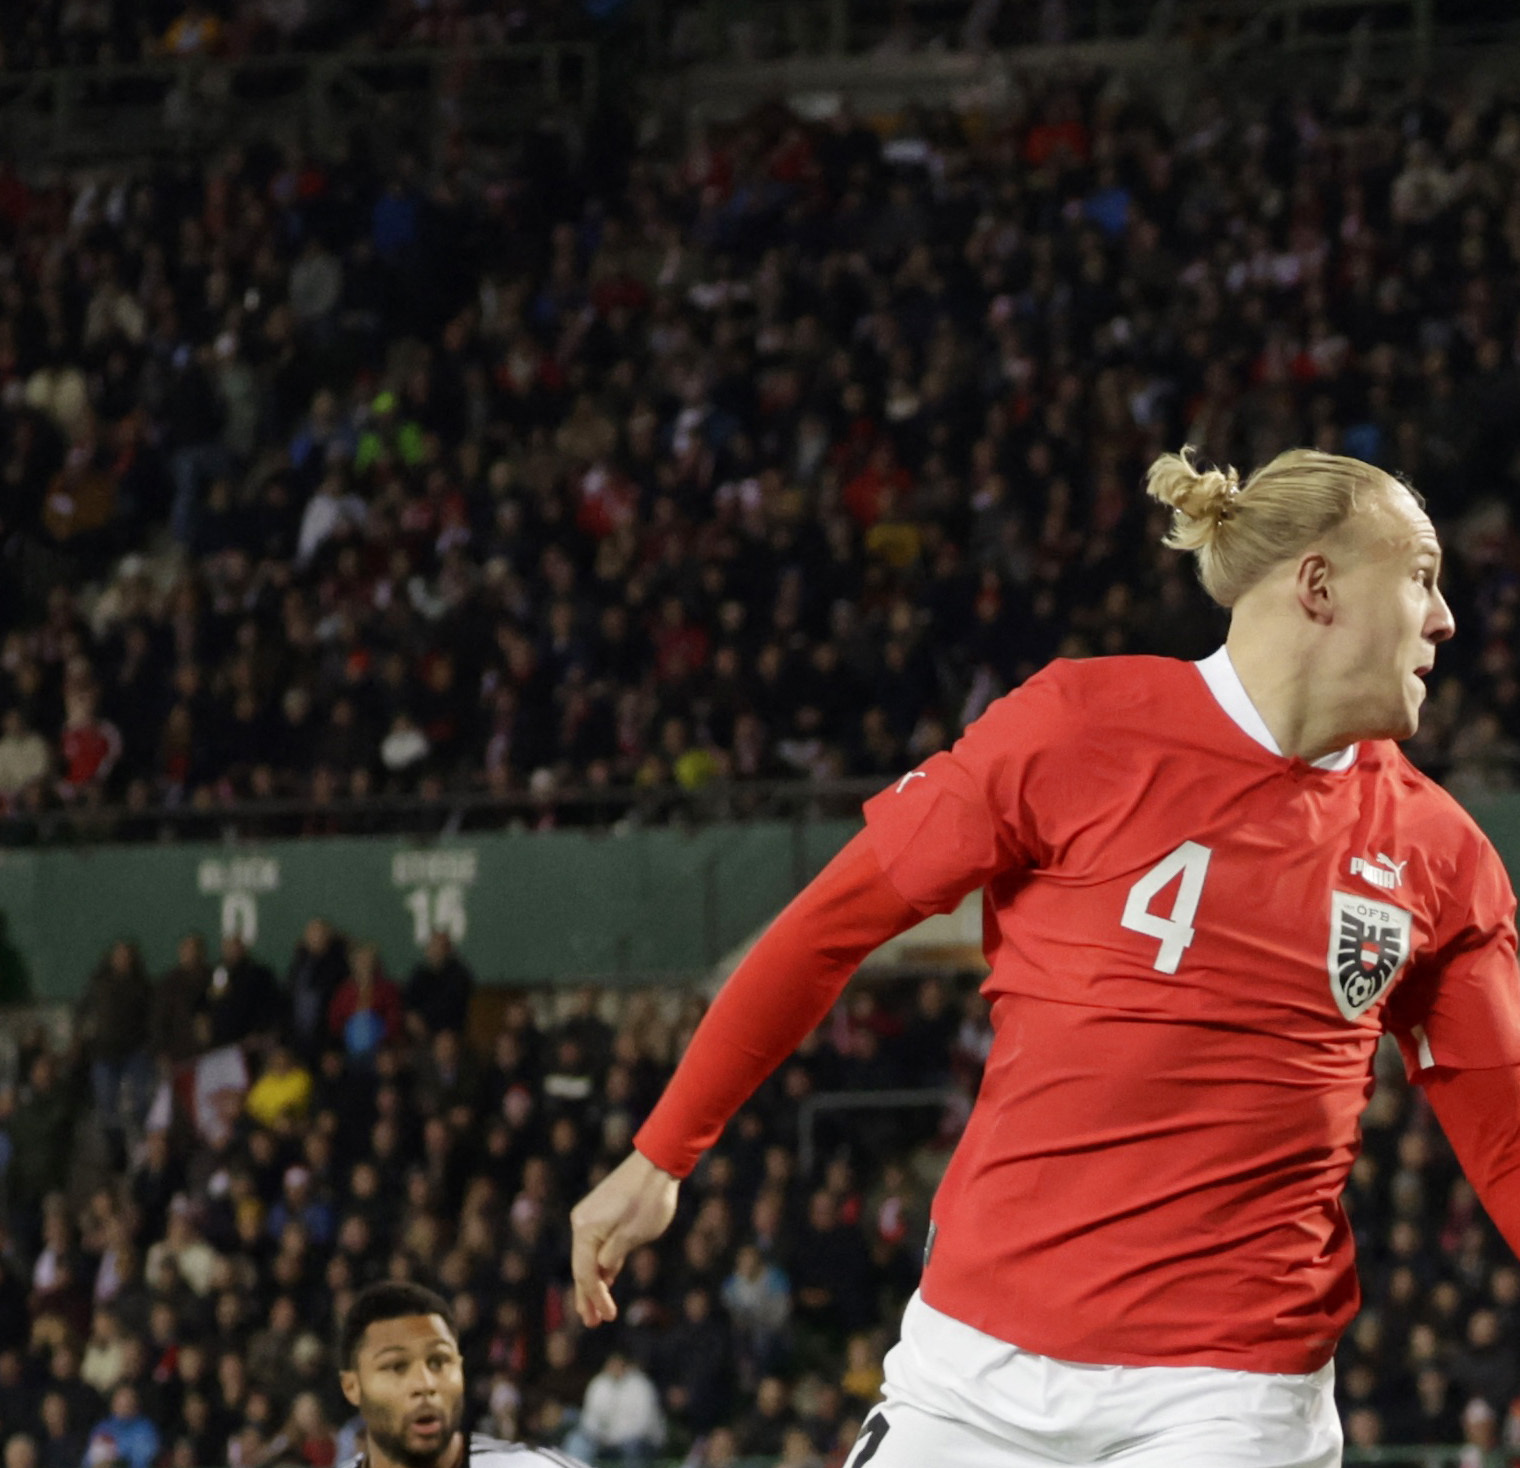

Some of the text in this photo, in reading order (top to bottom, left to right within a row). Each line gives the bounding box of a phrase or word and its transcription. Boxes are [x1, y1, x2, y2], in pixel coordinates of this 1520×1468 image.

[1350, 857, 1395, 889] PUMA
[1120, 839, 1212, 975] 4
[1356, 904, 1390, 922] ÖFB
